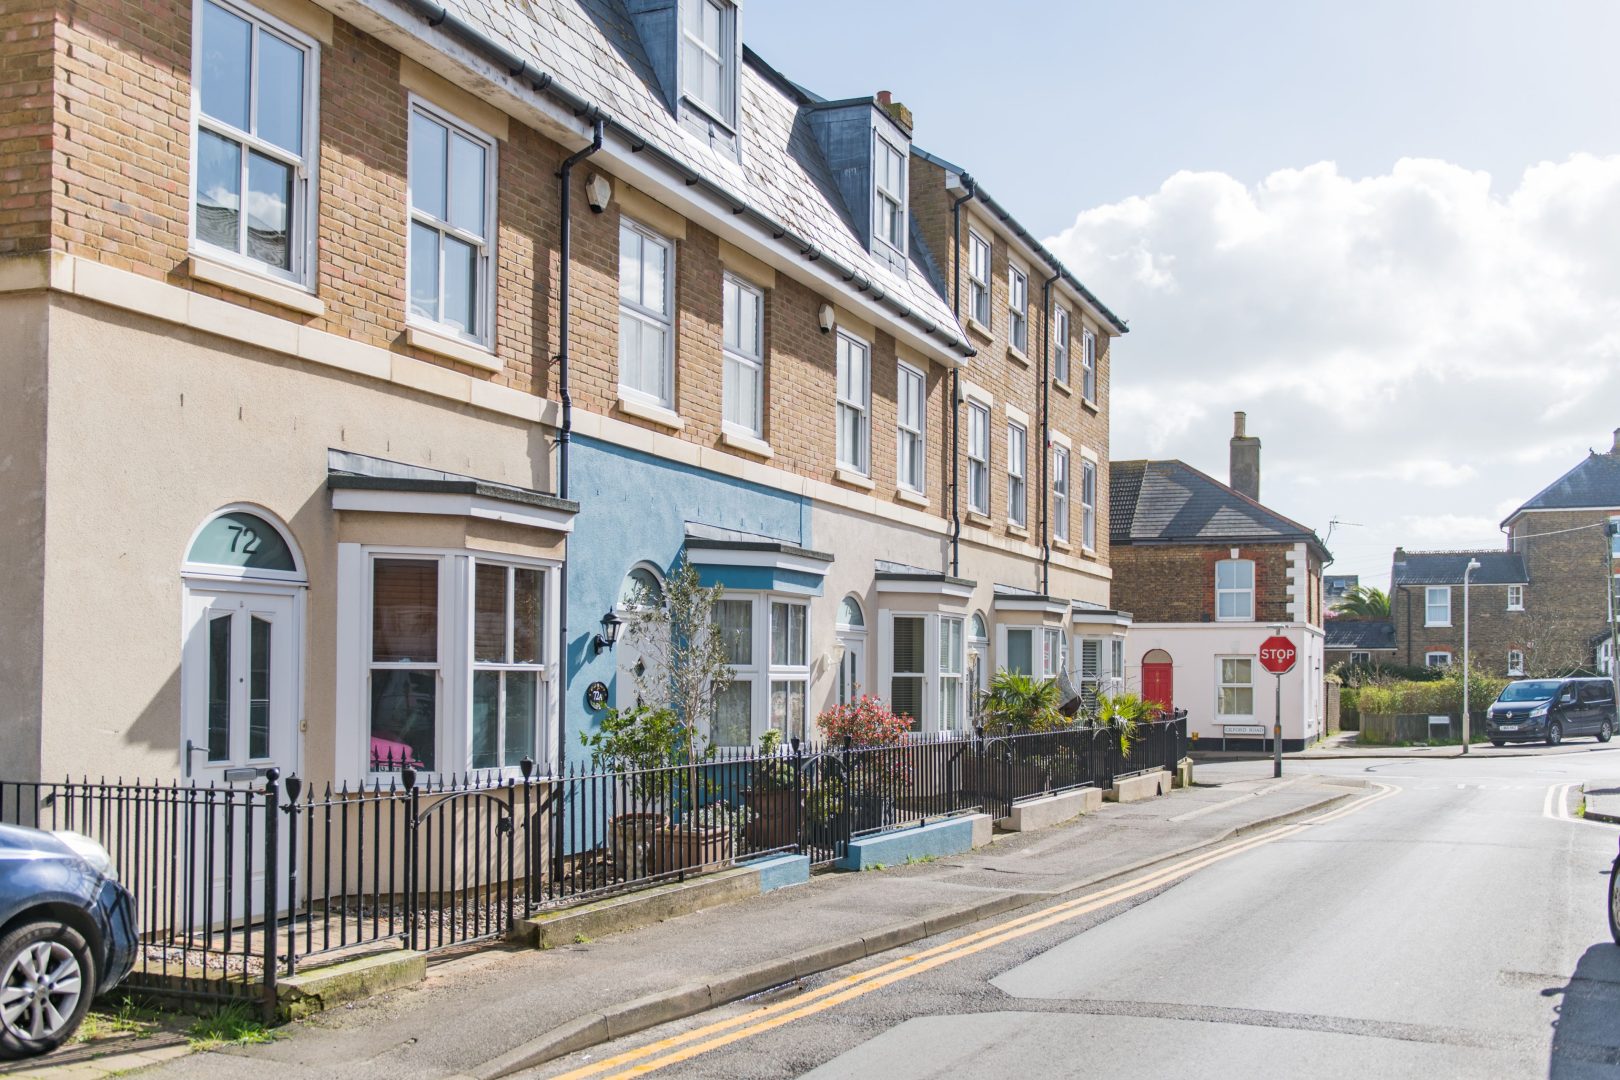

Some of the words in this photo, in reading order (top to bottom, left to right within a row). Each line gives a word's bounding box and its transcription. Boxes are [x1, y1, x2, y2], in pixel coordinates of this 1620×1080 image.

[228, 525, 257, 554] 72
[1261, 649, 1295, 660] STOP
[593, 690, 603, 701] 72A
